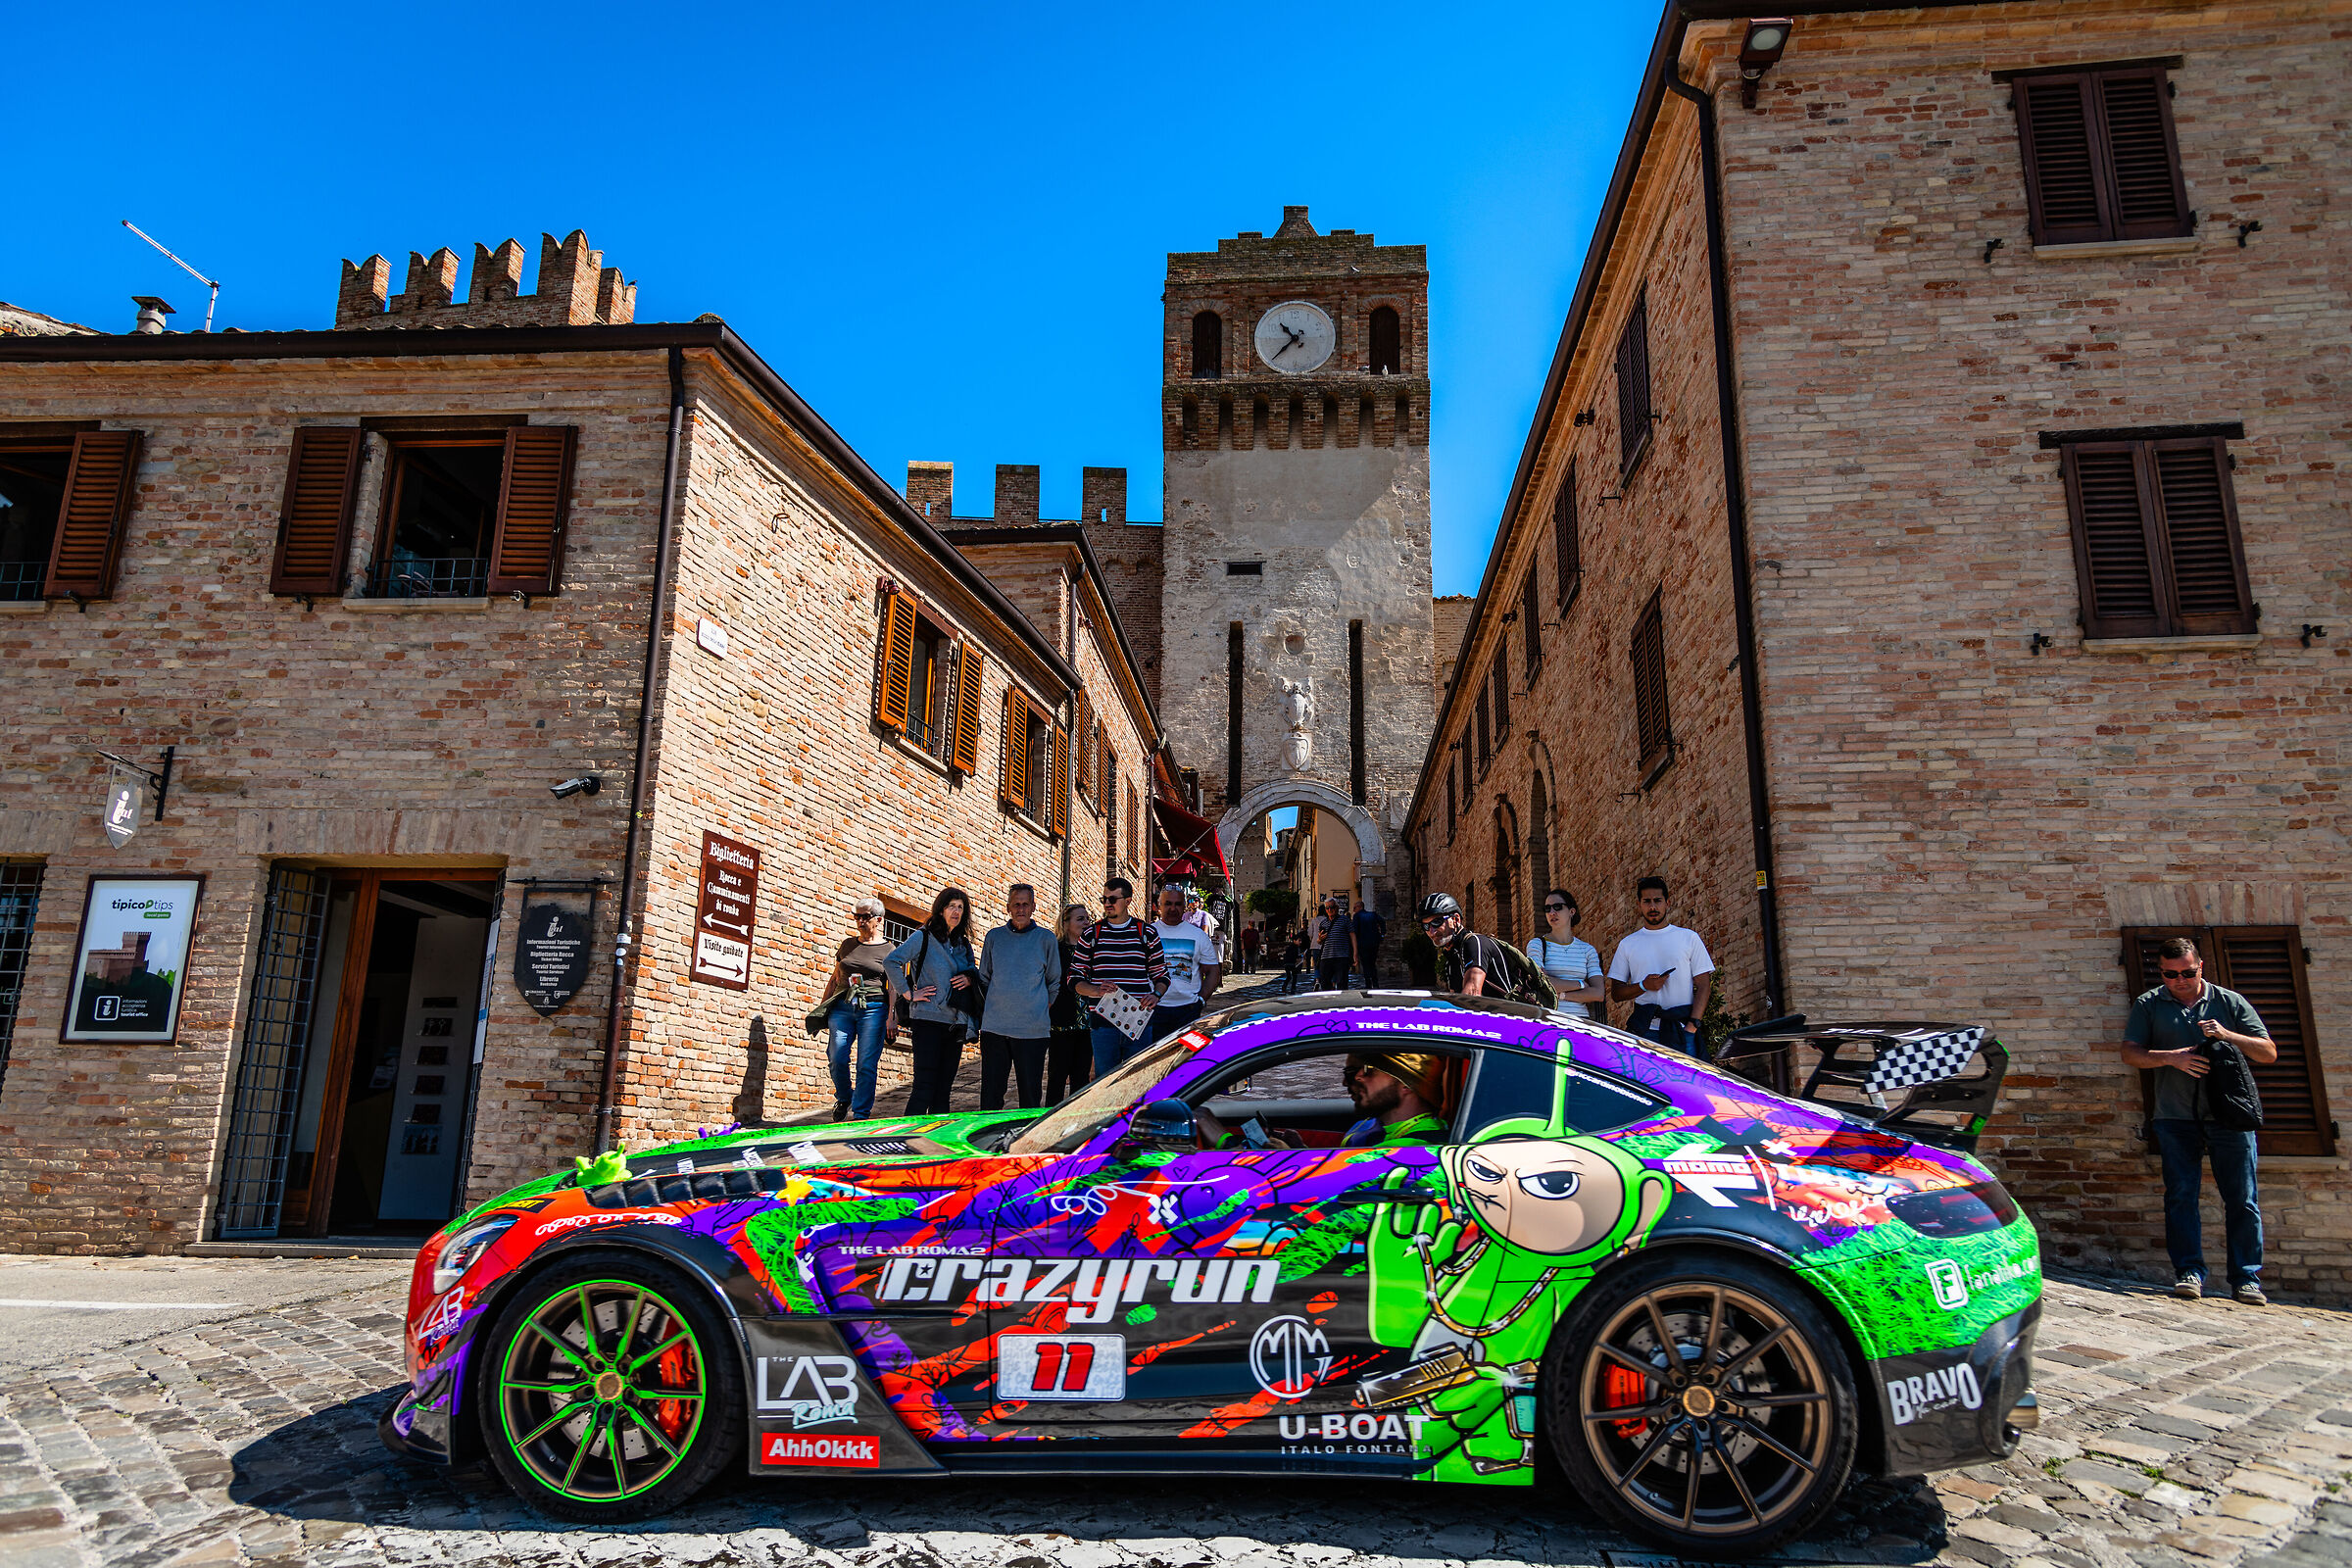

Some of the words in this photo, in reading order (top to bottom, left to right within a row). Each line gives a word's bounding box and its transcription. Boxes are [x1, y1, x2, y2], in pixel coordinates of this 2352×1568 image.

[710, 841, 754, 870] Biglietteria
[719, 869, 737, 886] Rocca
[737, 878, 742, 887] e
[112, 899, 145, 911] tipico
[154, 900, 173, 911] tips
[708, 882, 751, 905] Camminamenti
[715, 899, 722, 910] di
[722, 904, 739, 916] ronda
[704, 938, 721, 952] Visite
[721, 946, 744, 958] guidate
[838, 1246, 873, 1254] THE
[875, 1246, 914, 1254] LAB
[1963, 1254, 2038, 1292] fanatiko.co
[1031, 1342, 1096, 1392] 11
[757, 1355, 859, 1409] LAB
[1886, 1363, 1983, 1425] BRAVO
[791, 1401, 856, 1426] Roma
[1278, 1413, 1431, 1440] U-BOAT
[768, 1438, 874, 1459] AhhOkkk
[1281, 1445, 1336, 1454] ITALO
[1346, 1445, 1433, 1454] FONTANA
